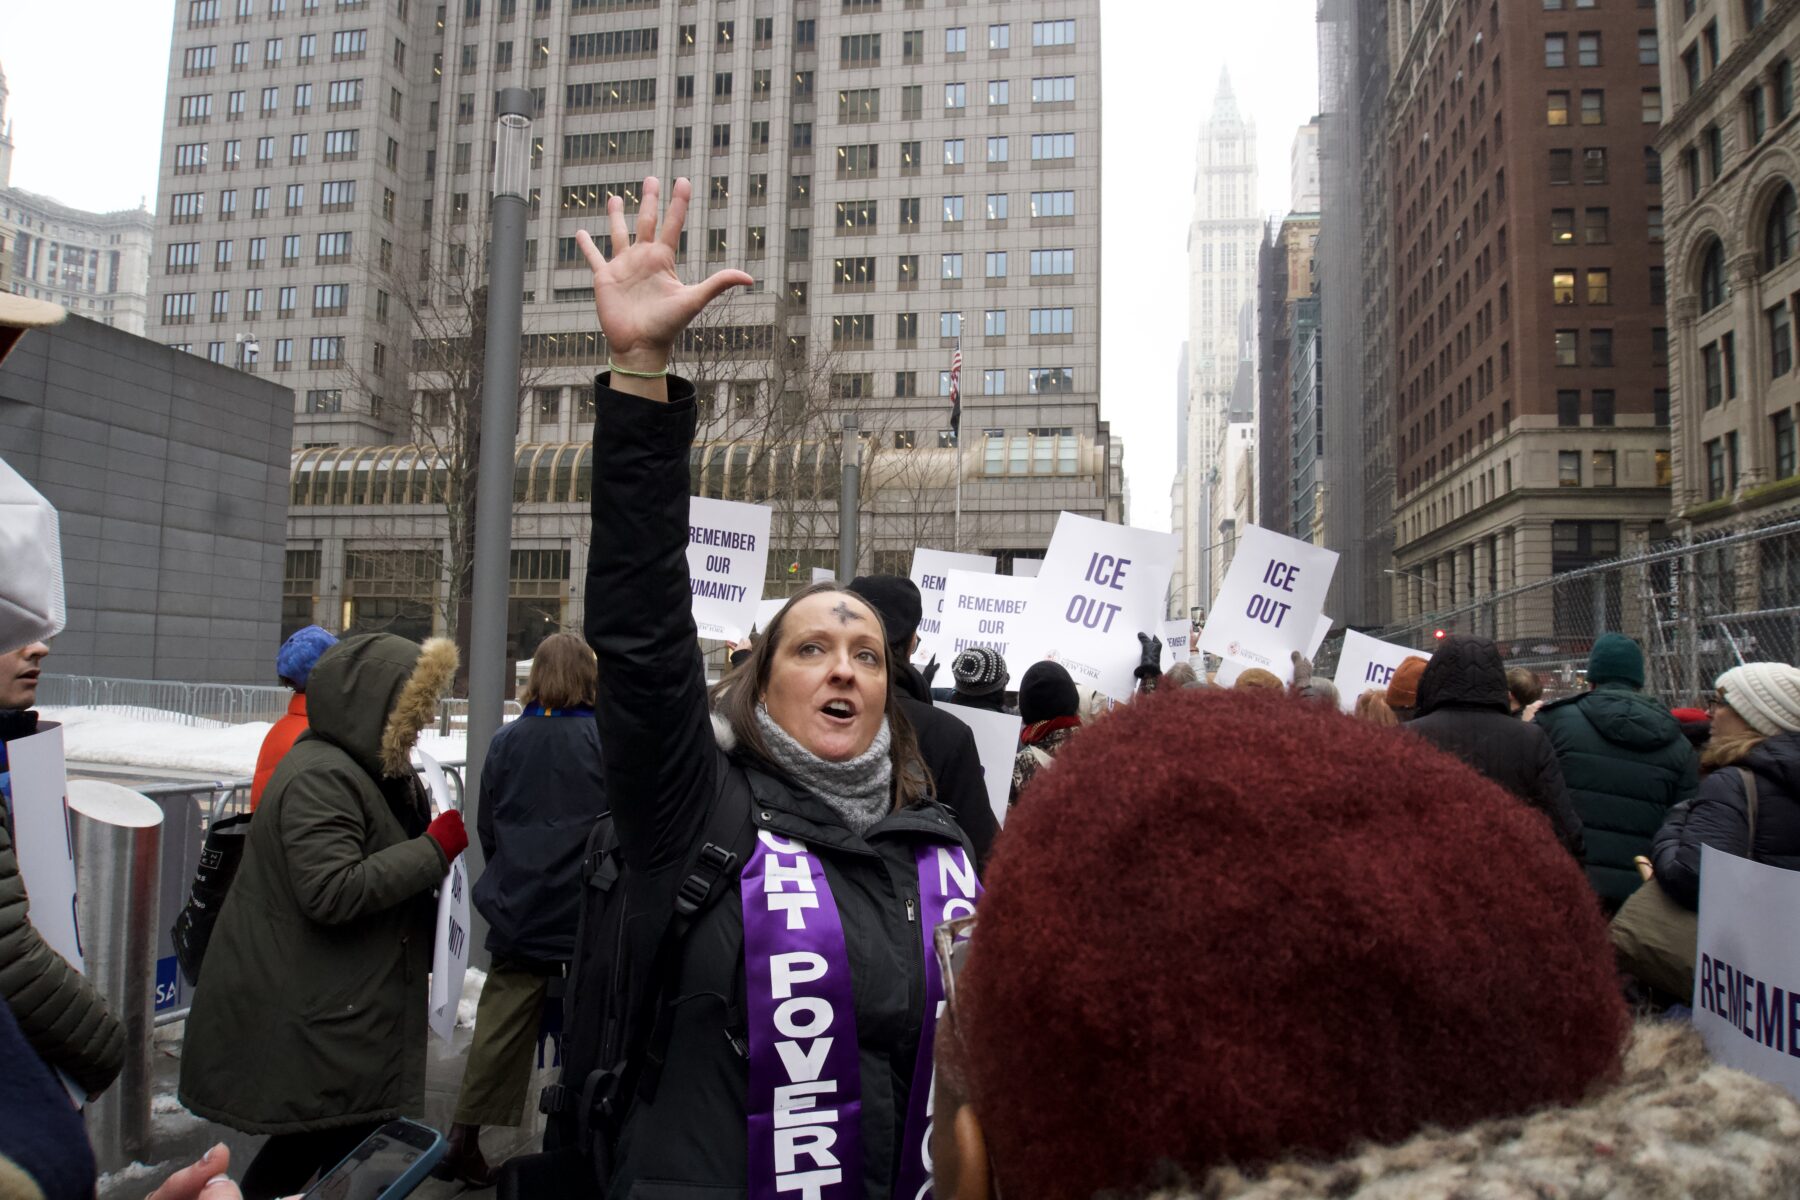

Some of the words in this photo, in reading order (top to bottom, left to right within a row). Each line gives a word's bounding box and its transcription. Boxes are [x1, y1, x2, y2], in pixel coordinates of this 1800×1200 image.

[689, 526, 755, 552] REMEMBER
[706, 555, 730, 574] OUR
[1085, 552, 1131, 590] ICE
[1263, 559, 1300, 592] ICE
[978, 619, 1005, 634] OUR
[1066, 594, 1122, 633] OUT
[1246, 594, 1291, 628] OUT
[954, 638, 1009, 656] HUMANI
[937, 848, 977, 944] NO
[769, 951, 842, 1200] POVERT
